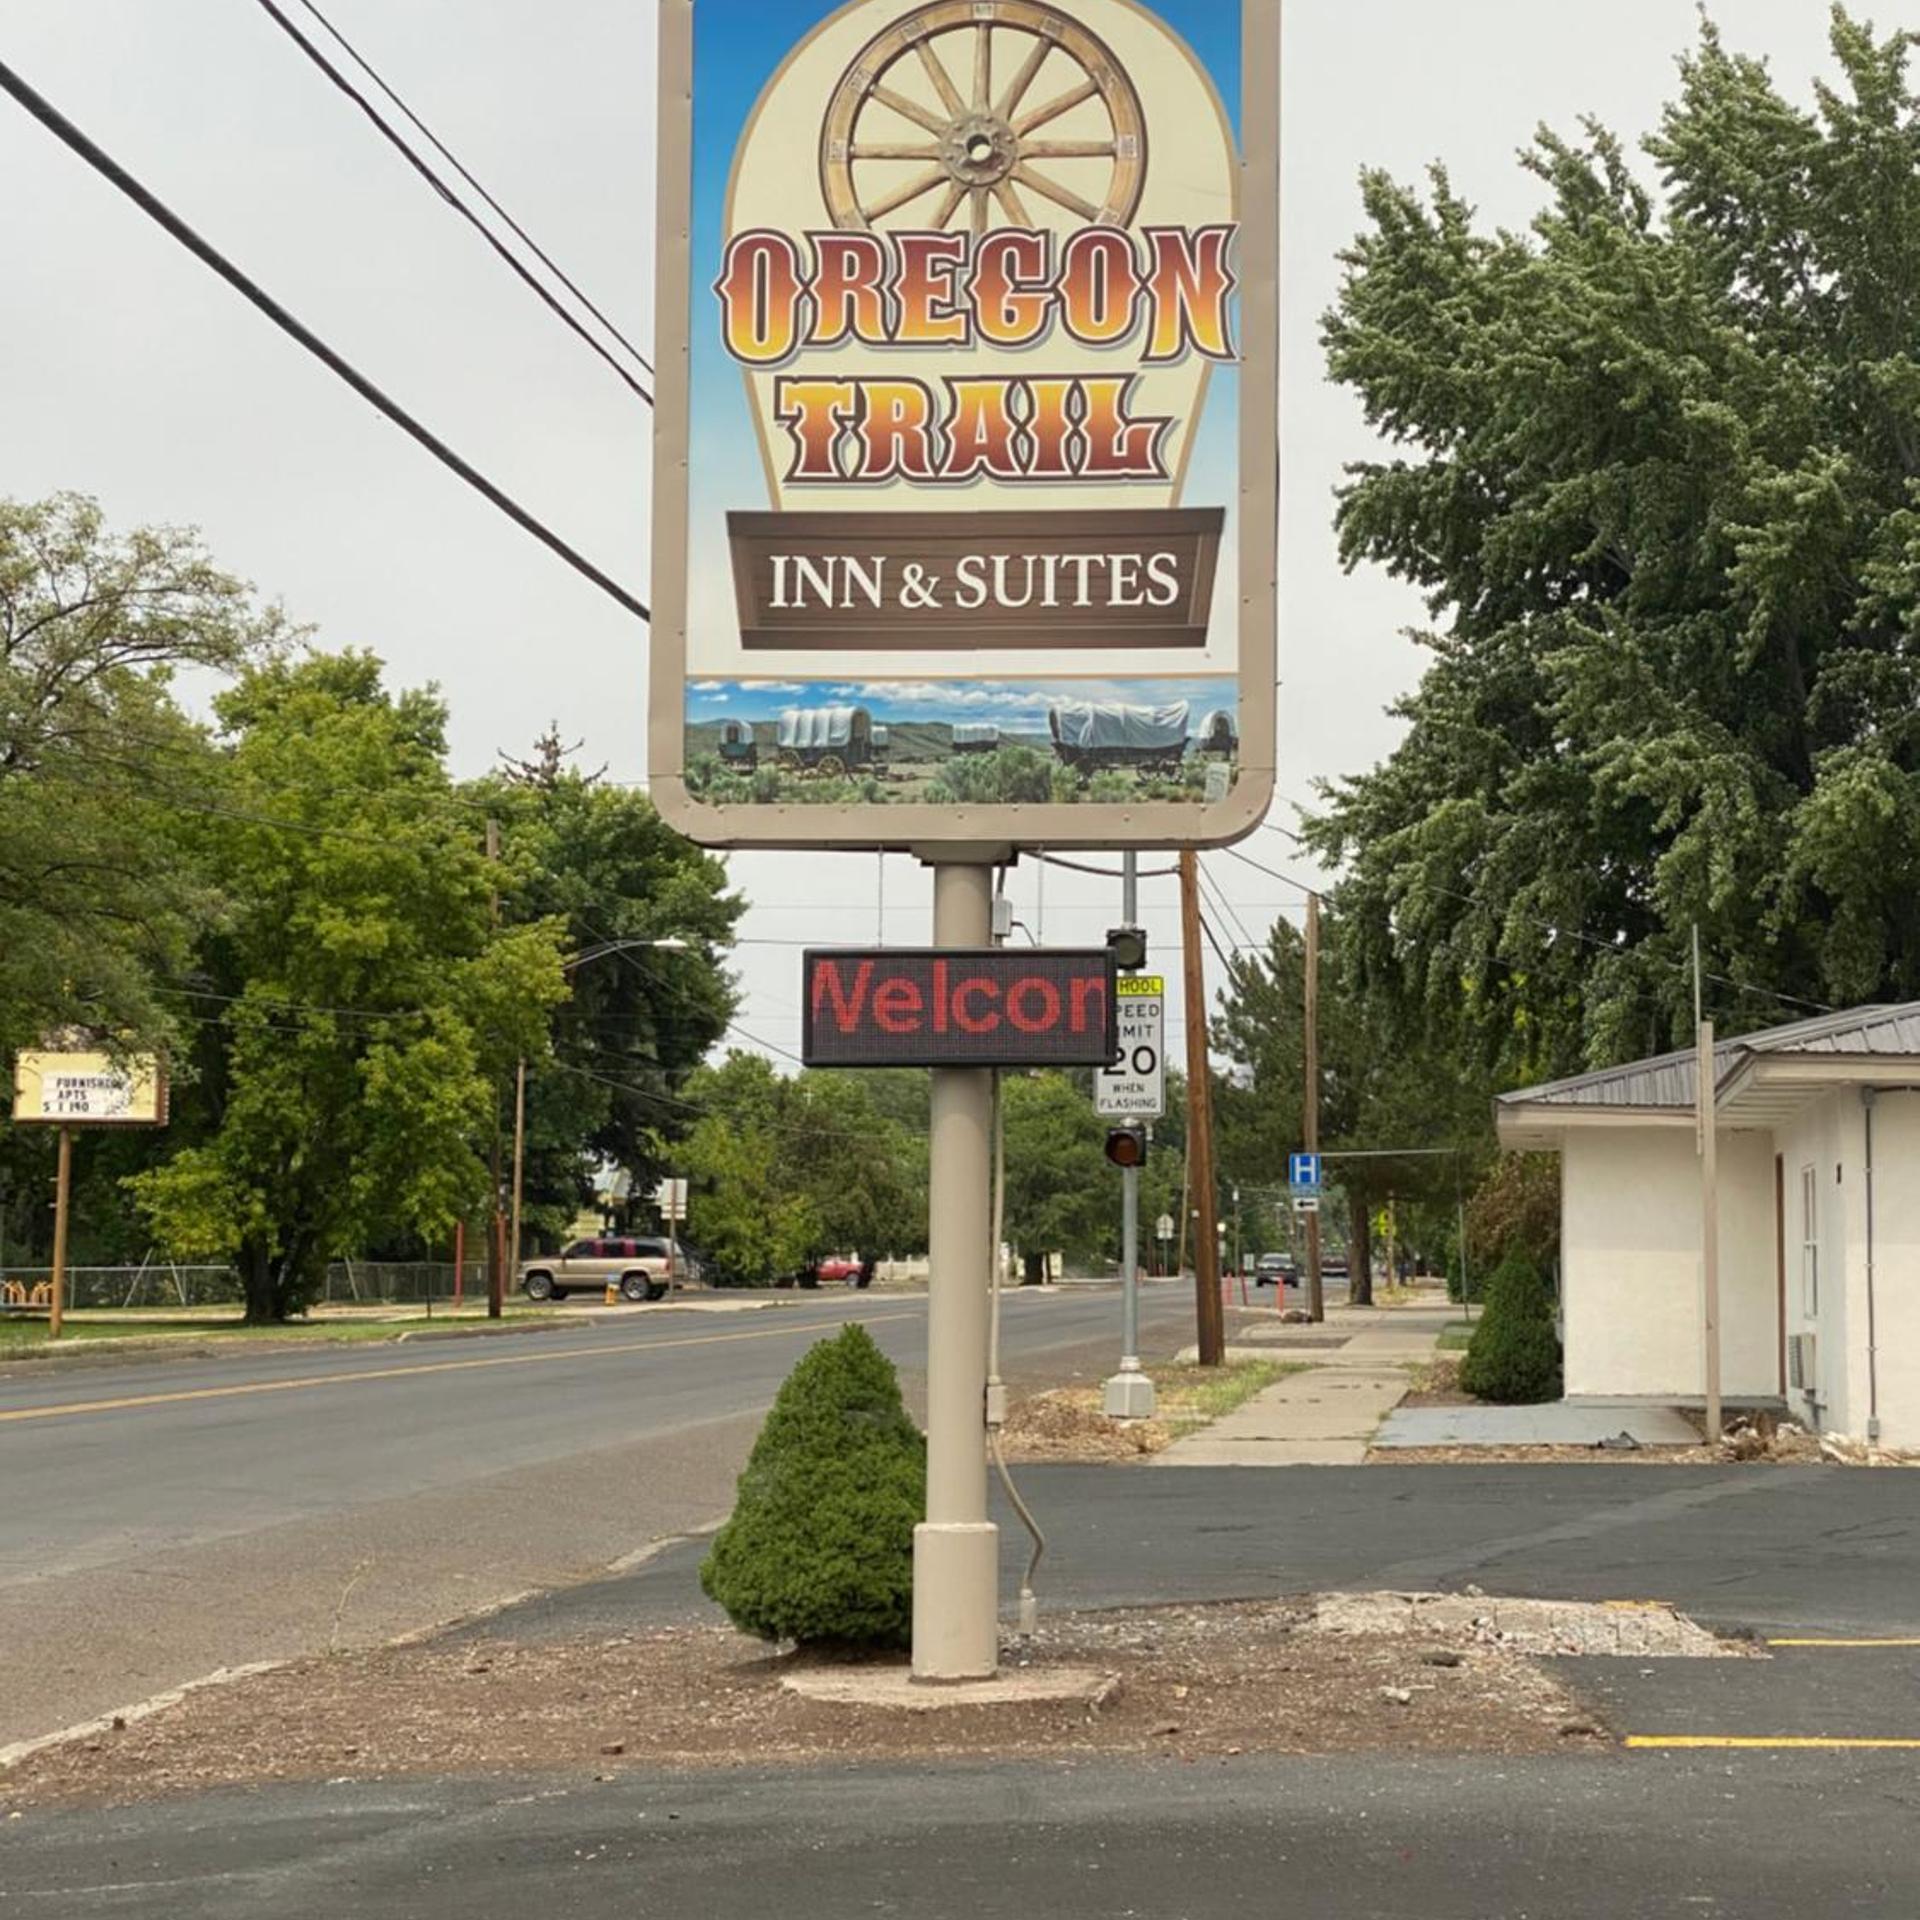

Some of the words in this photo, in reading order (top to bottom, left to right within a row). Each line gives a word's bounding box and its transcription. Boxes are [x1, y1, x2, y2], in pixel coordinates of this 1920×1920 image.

[712, 225, 1237, 366] OREGON
[774, 373, 1177, 483] TRAIL
[768, 555, 886, 609] INN
[899, 563, 943, 609] &
[955, 552, 1180, 608] SUITES
[1119, 979, 1160, 993] HOOL
[1102, 1045, 1156, 1076] 20
[58, 1089, 87, 1101] APTS
[1112, 1083, 1145, 1094] WHEN
[1100, 1097, 1157, 1109] FLASHING
[1295, 1156, 1316, 1184] H
